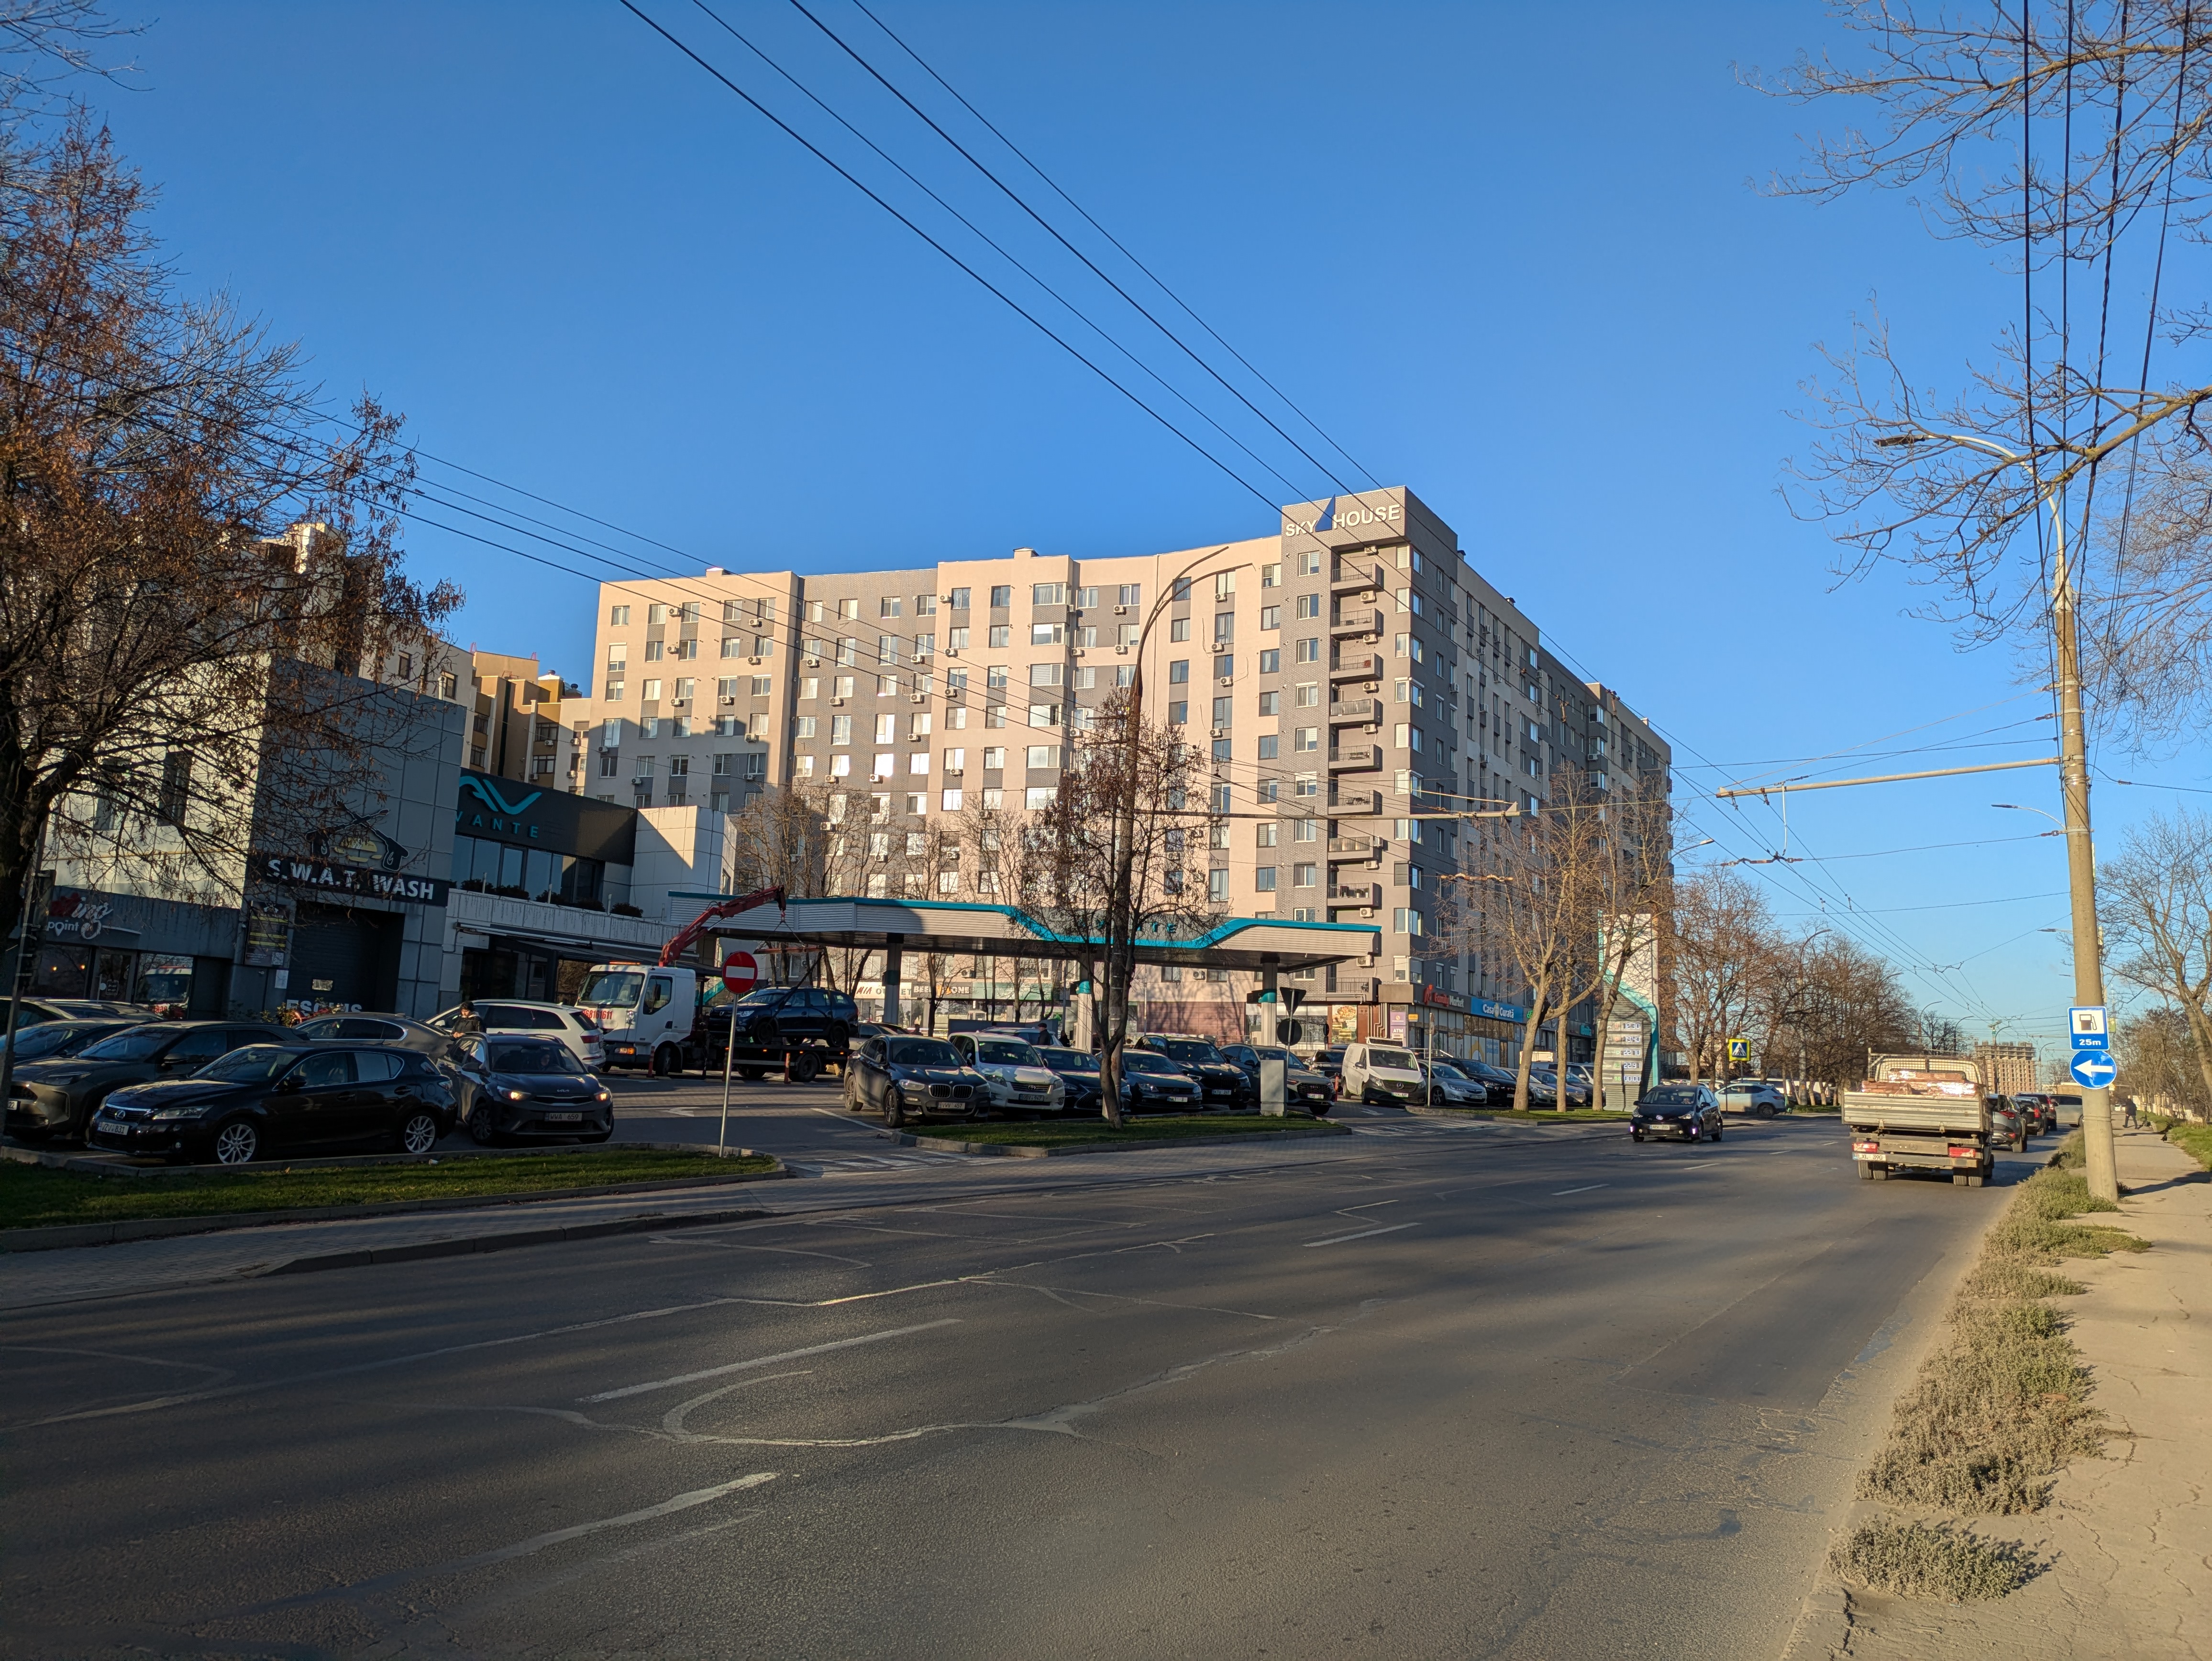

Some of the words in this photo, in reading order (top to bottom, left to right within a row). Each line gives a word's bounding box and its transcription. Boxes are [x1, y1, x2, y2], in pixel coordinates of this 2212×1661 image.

[1285, 520, 1317, 537] SKY
[1333, 504, 1400, 529] HOUSE
[373, 874, 434, 900] WASH
[46, 919, 79, 936] point
[913, 986, 932, 994] BEE
[1433, 992, 1449, 1007] Family
[1449, 995, 1464, 1008] Market
[583, 1009, 613, 1020] 68161611
[1483, 1004, 1494, 1015] Casa
[1500, 1007, 1514, 1019] Curată
[101, 1123, 111, 1132] VZV
[115, 1126, 125, 1134] 831
